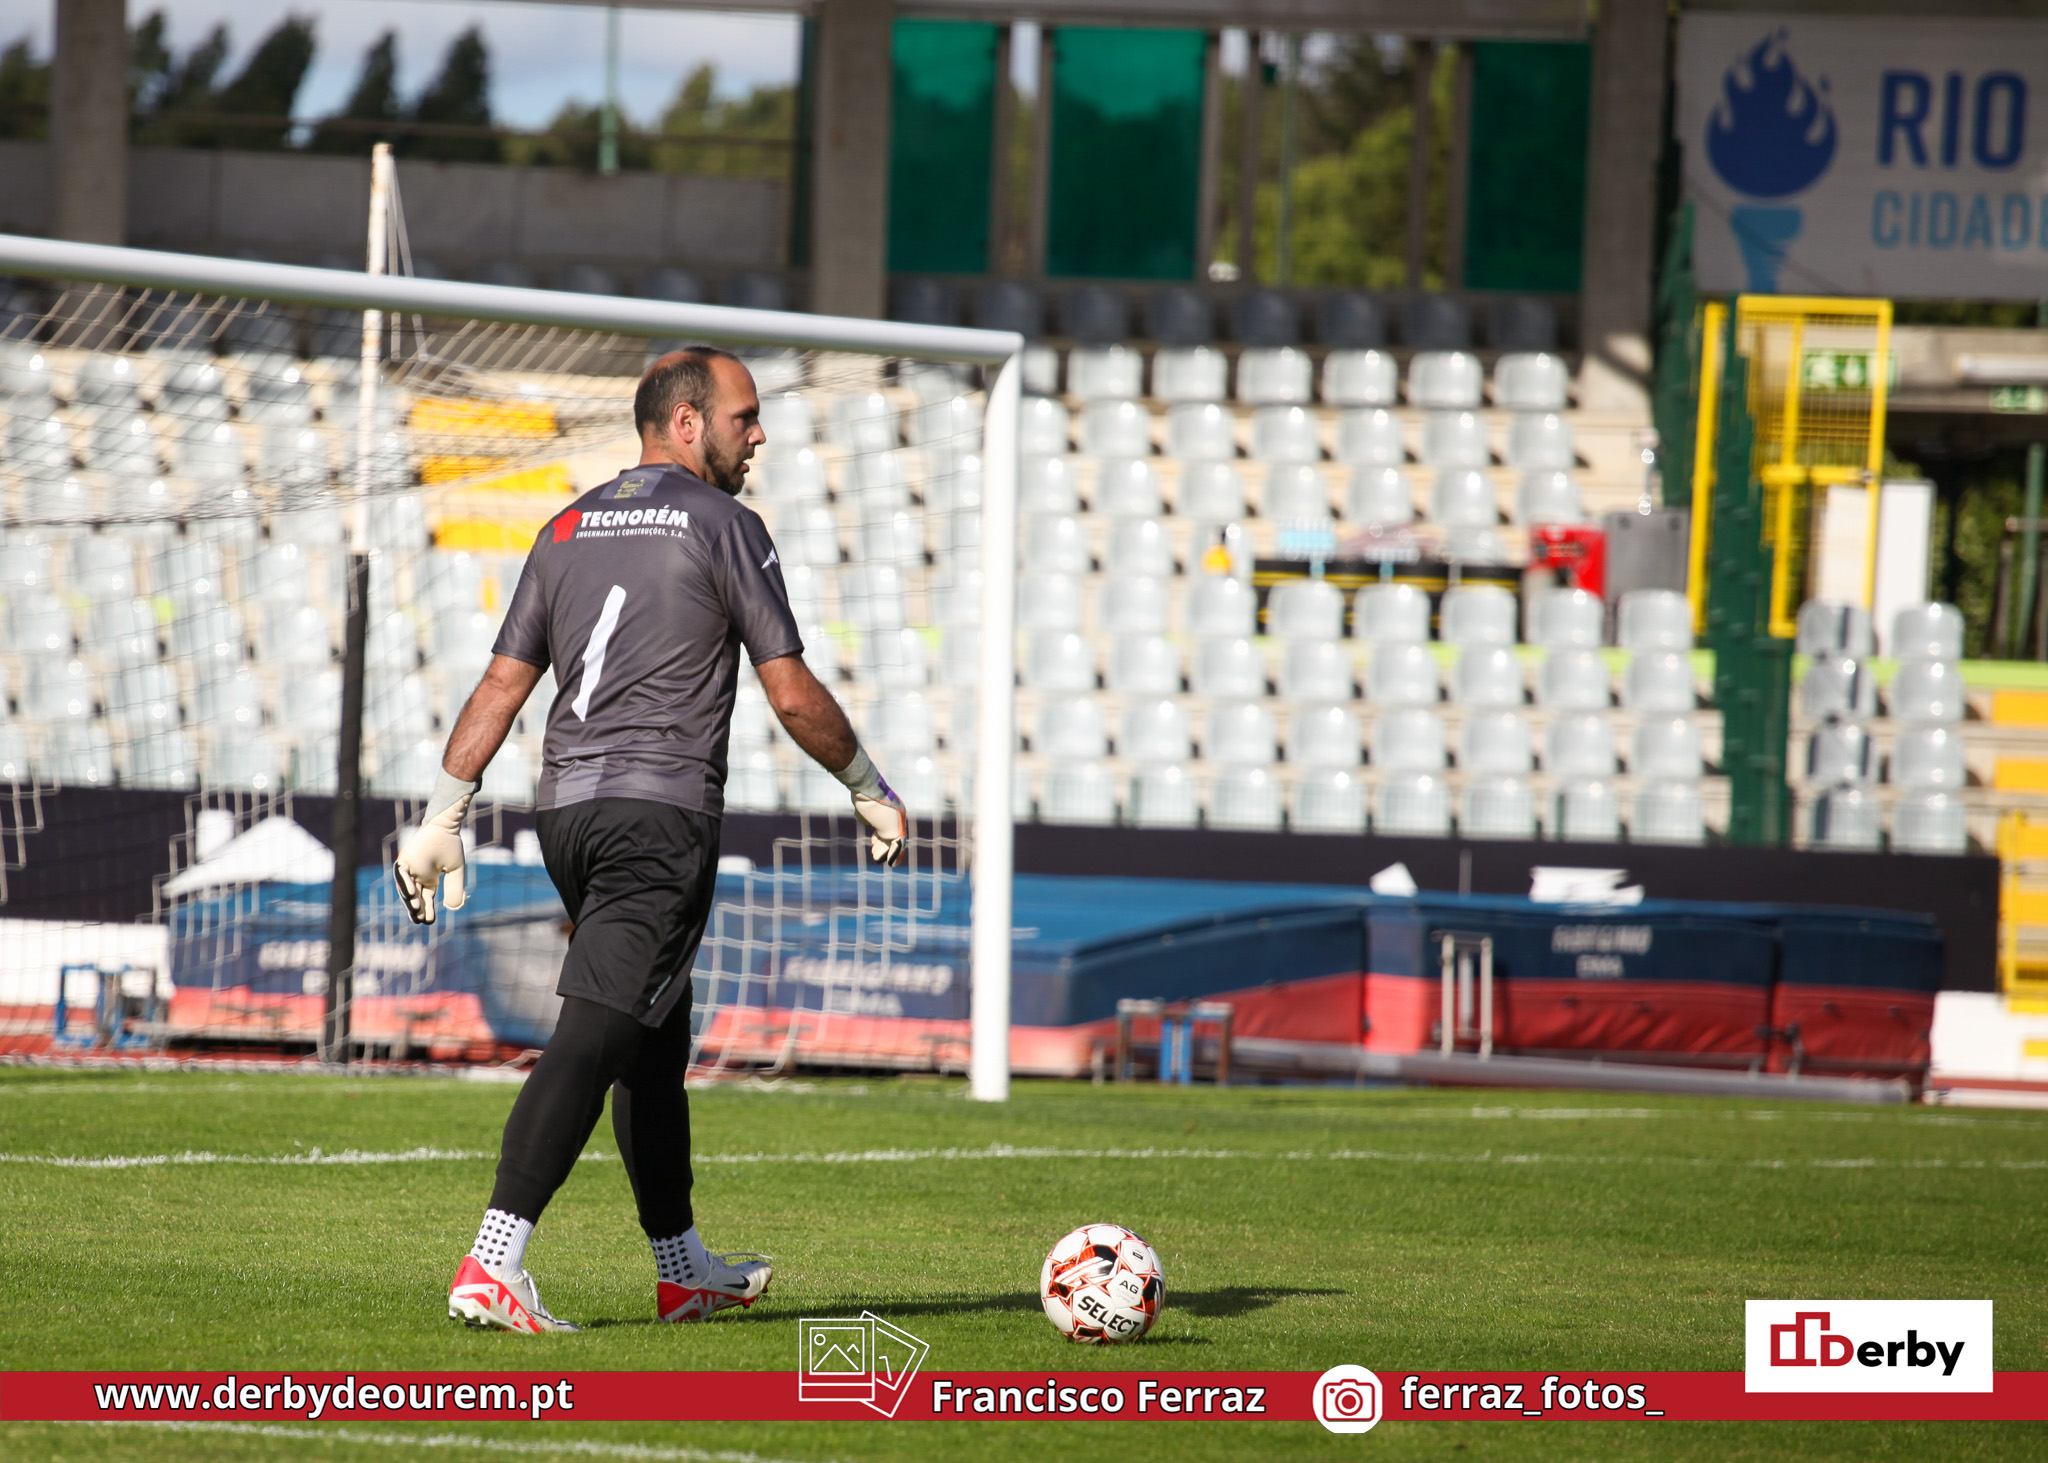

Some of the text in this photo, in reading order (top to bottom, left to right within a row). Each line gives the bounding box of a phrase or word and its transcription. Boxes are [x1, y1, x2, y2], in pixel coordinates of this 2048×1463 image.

[1877, 70, 2028, 171] RIO
[580, 504, 689, 528] TECNORÉM
[576, 529, 615, 539] ENGENHARIA
[616, 528, 621, 537] E
[670, 530, 686, 539] S.A.
[571, 584, 607, 722] 1
[1118, 1279, 1140, 1295] AG
[1077, 1295, 1141, 1336] SELECT
